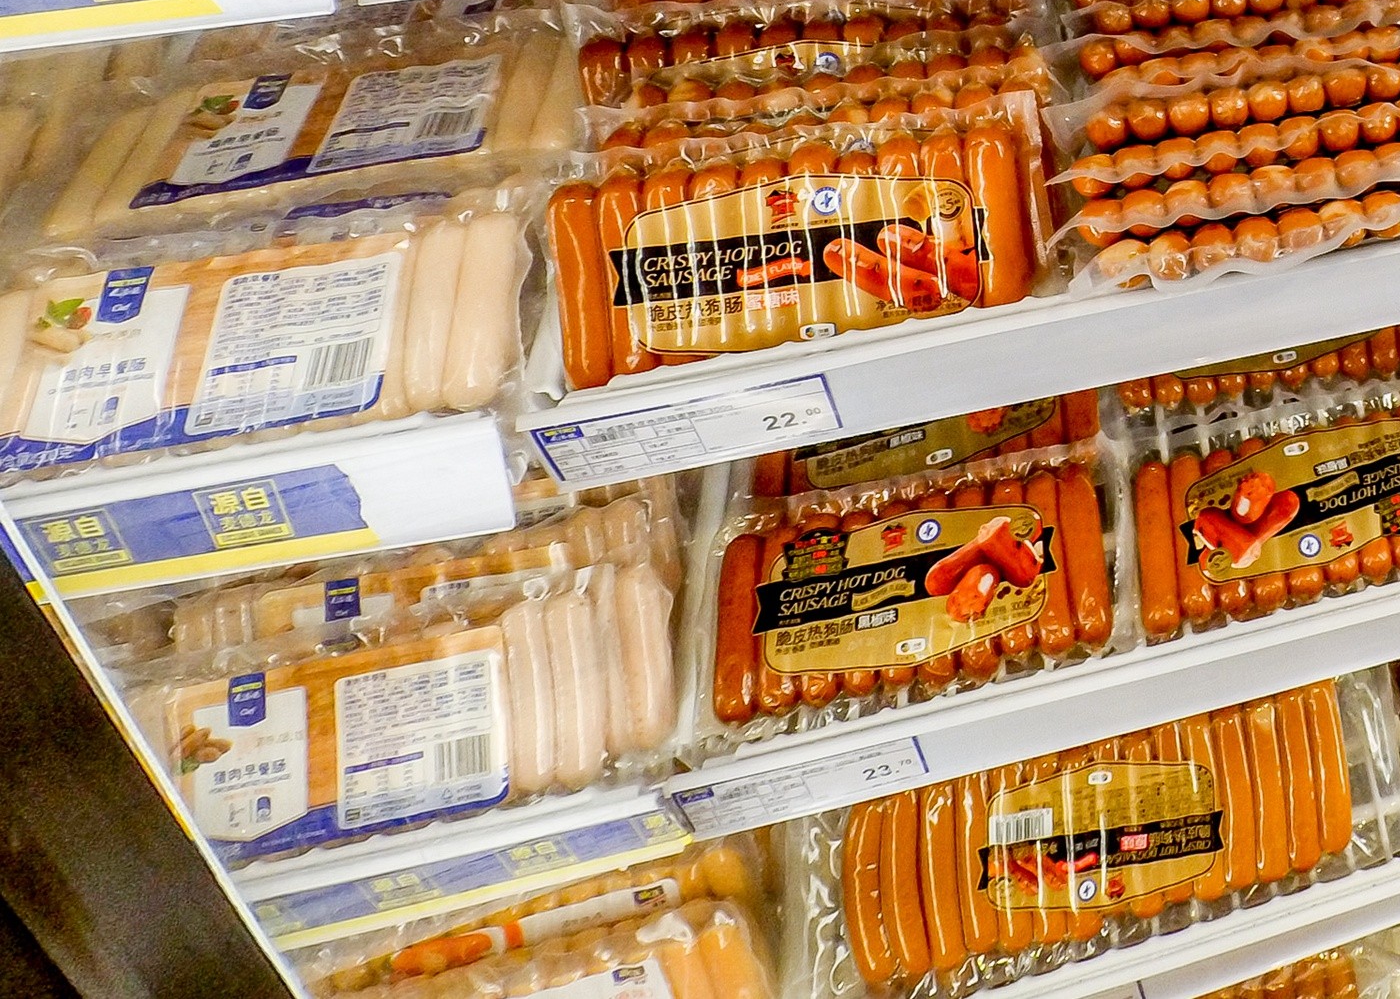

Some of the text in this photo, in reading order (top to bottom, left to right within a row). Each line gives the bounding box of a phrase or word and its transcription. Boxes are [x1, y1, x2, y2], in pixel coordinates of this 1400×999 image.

[643, 240, 802, 272] CRISPY HOT DOG
[645, 265, 733, 288] SAUSAGE
[763, 406, 822, 431] 22.00
[208, 487, 270, 515] 源自
[1318, 493, 1348, 512] DOG
[1347, 481, 1377, 502] HOT
[41, 516, 105, 542] 源自
[779, 581, 836, 601] CRISPY
[837, 573, 872, 592] HOT
[872, 566, 906, 581] DOG
[778, 592, 849, 616] SAUSAGE
